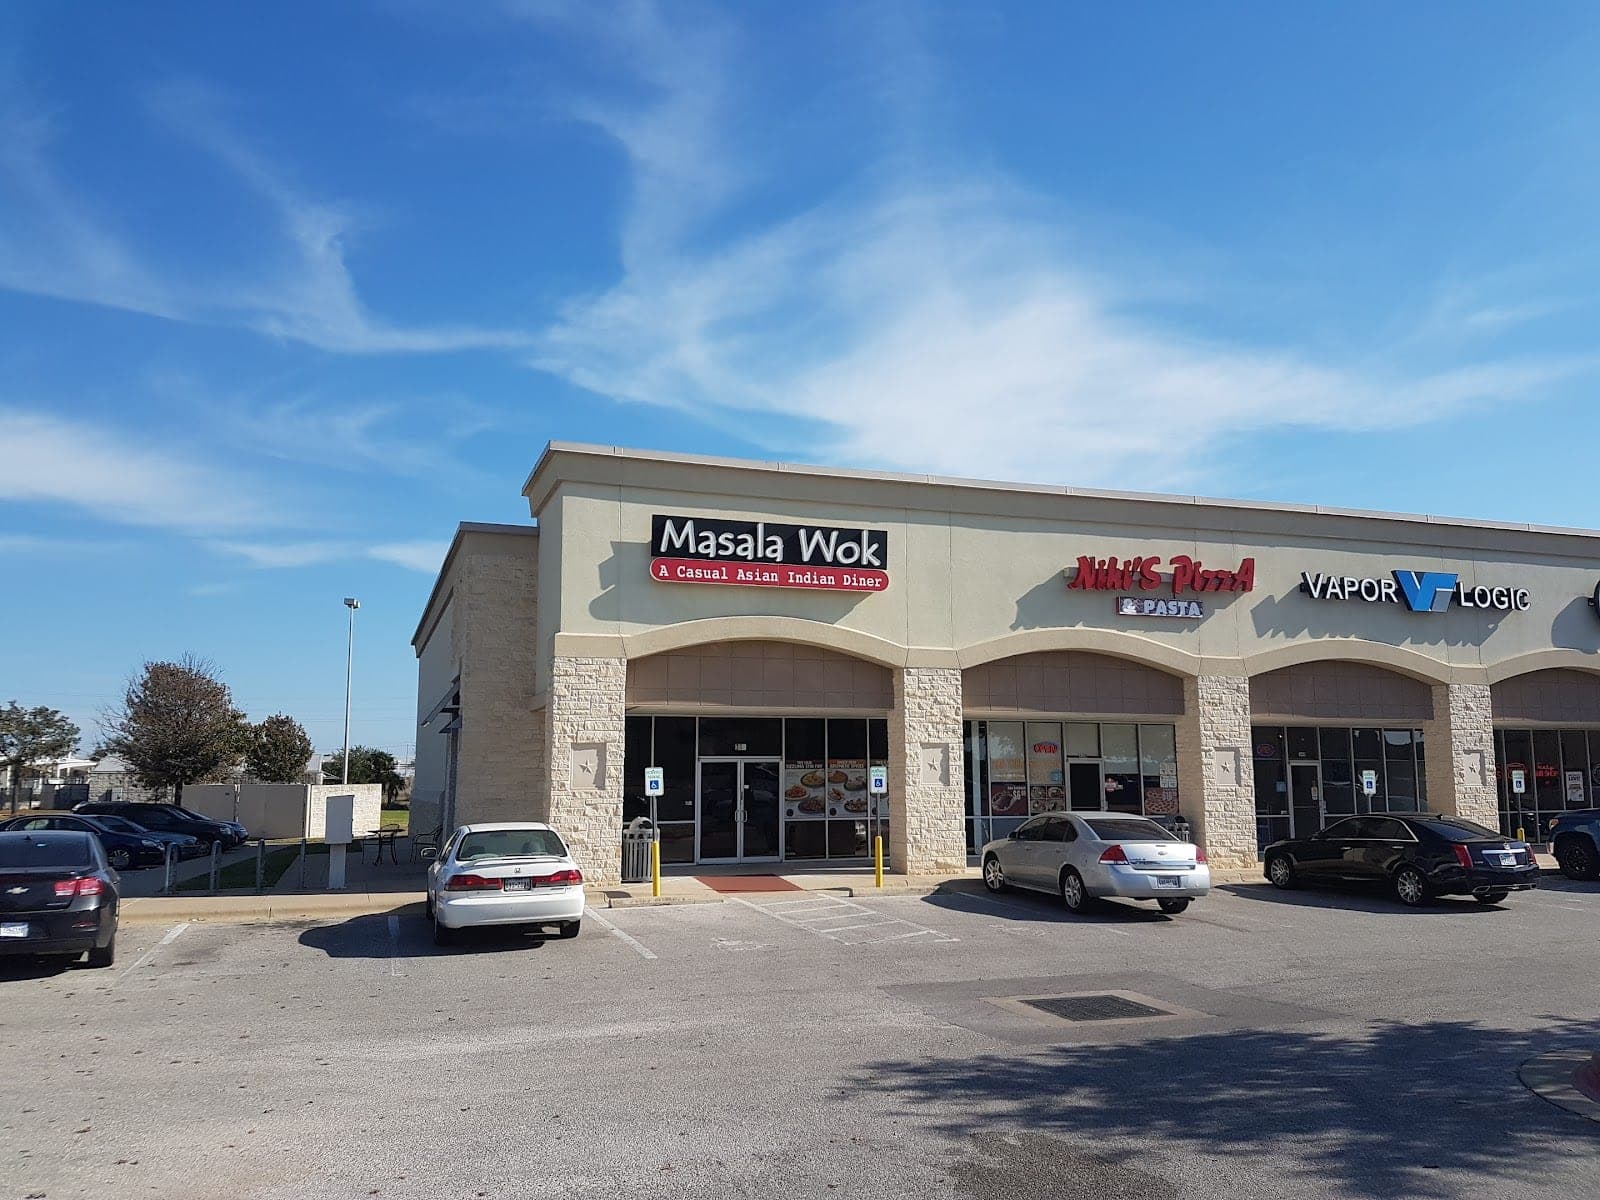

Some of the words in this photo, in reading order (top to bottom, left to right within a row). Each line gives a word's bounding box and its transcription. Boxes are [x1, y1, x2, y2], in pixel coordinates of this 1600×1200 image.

[660, 519, 785, 562] Masala
[799, 529, 882, 567] Wok
[659, 565, 669, 577] A
[677, 566, 728, 580] Casual
[737, 569, 779, 583] Asian
[788, 571, 836, 586] Indian
[843, 574, 882, 588] Diner
[1302, 571, 1398, 603] VAPOR
[1458, 581, 1531, 612] LOGIC
[1143, 600, 1201, 616] PASTA
